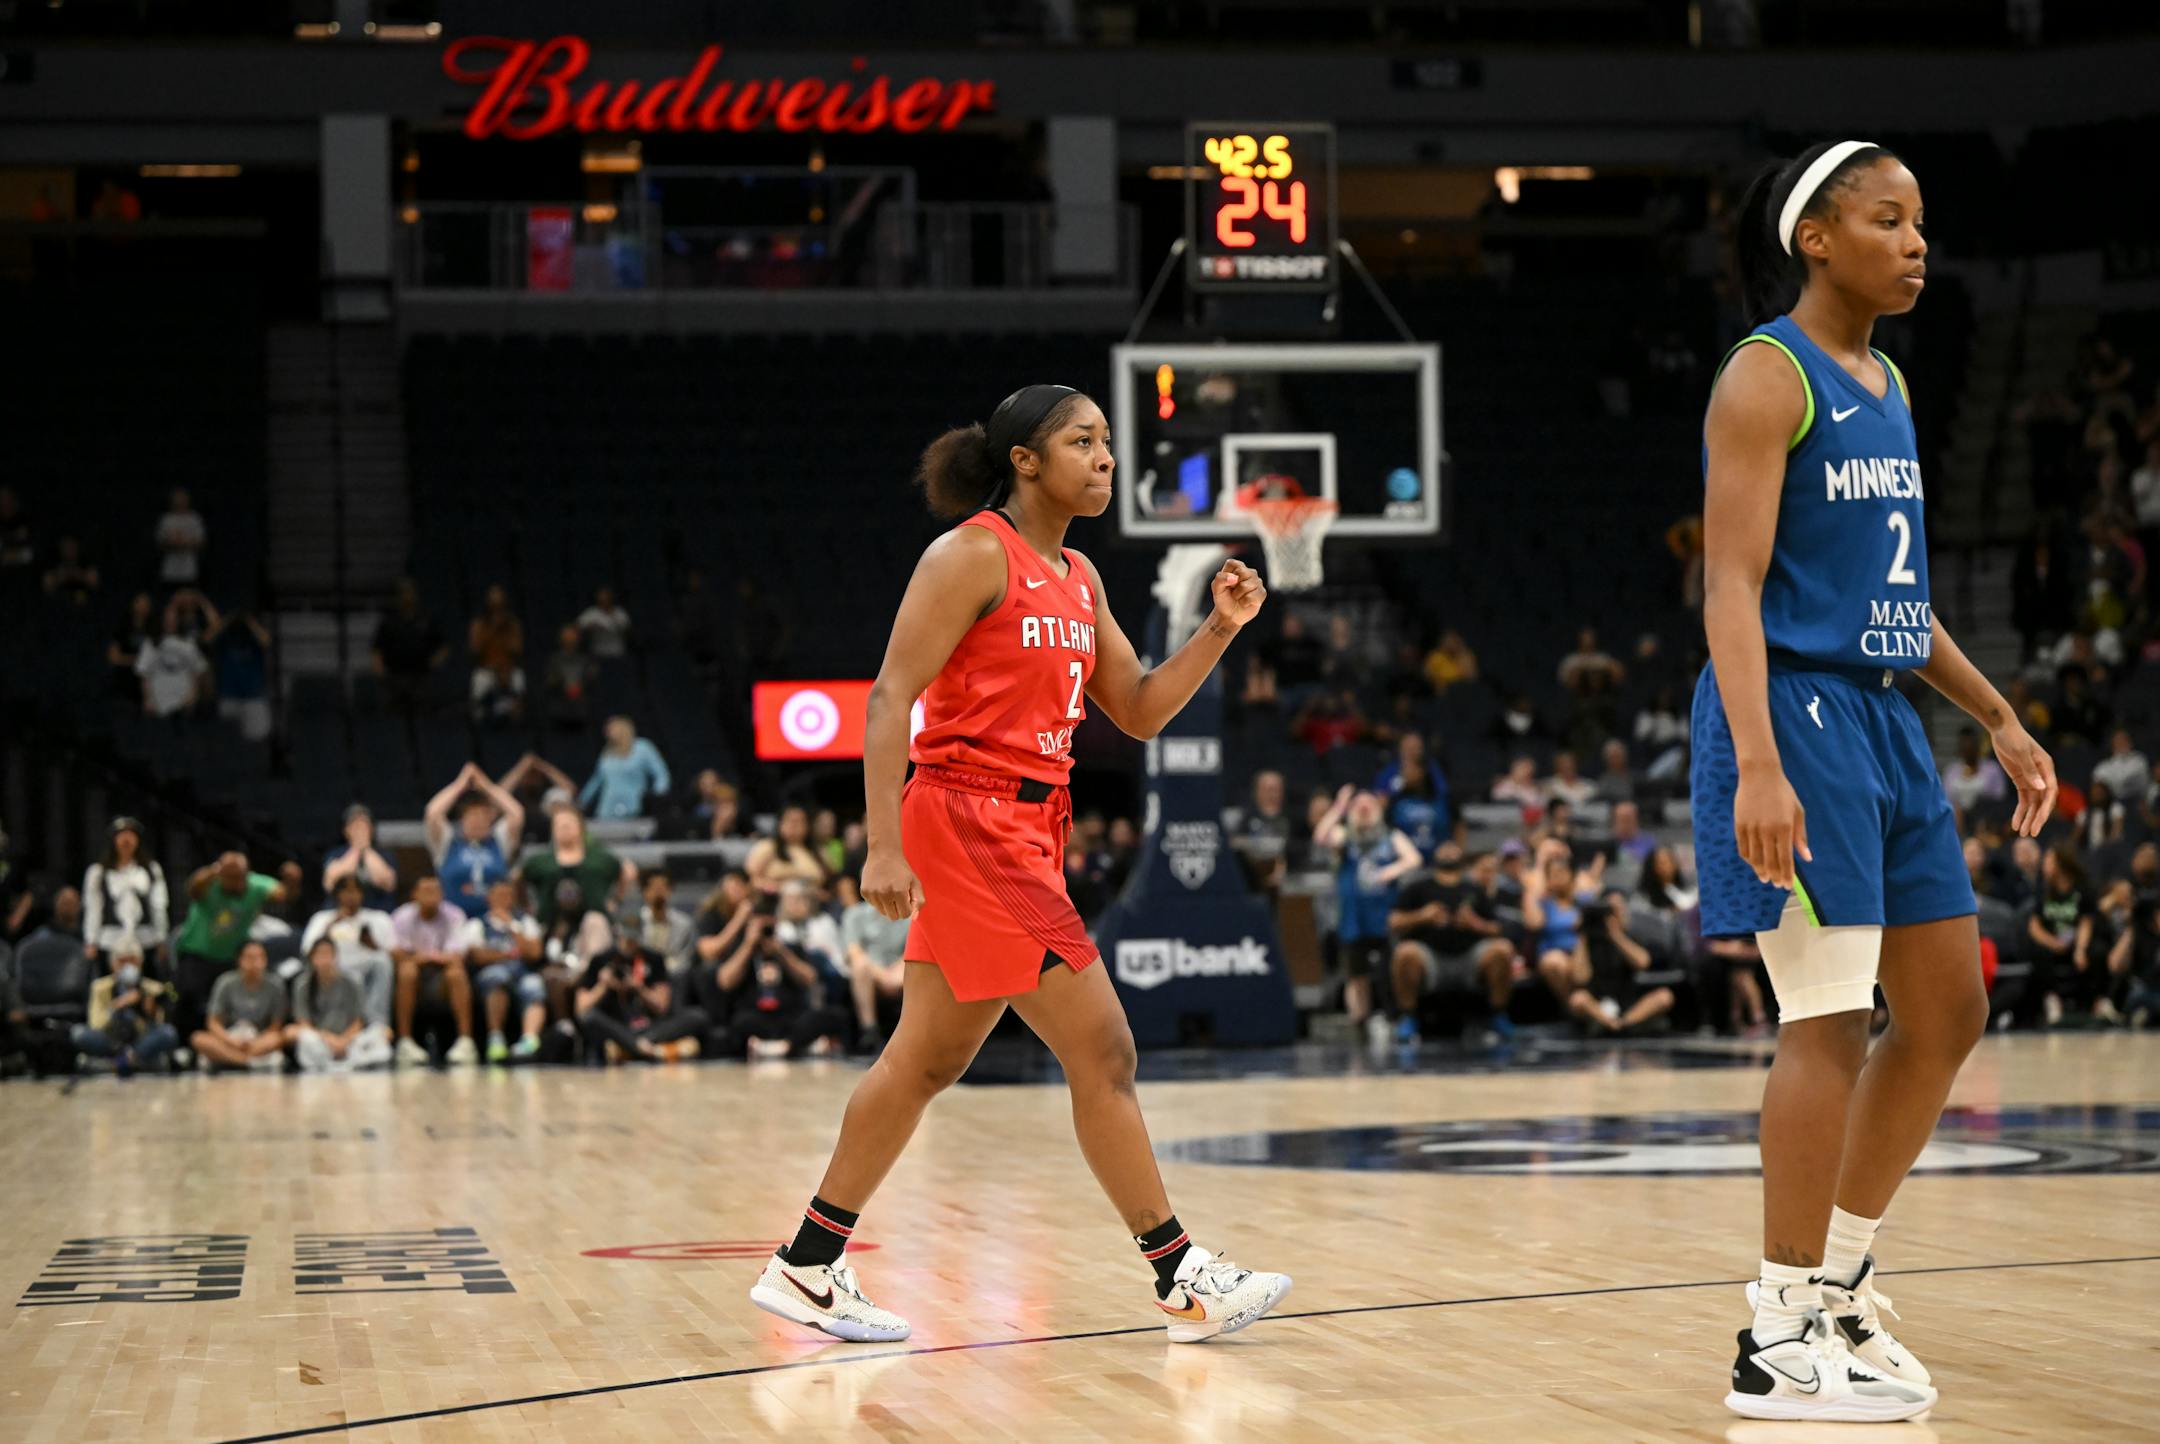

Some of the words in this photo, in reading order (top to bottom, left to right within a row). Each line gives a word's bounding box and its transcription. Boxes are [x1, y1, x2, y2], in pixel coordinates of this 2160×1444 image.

[442, 35, 995, 140] Budweiser
[1205, 135, 1292, 178] 42.5
[1217, 177, 1306, 247] 24
[1887, 511, 1917, 585] 2
[1065, 661, 1084, 719] 2
[1174, 936, 1271, 977] bank
